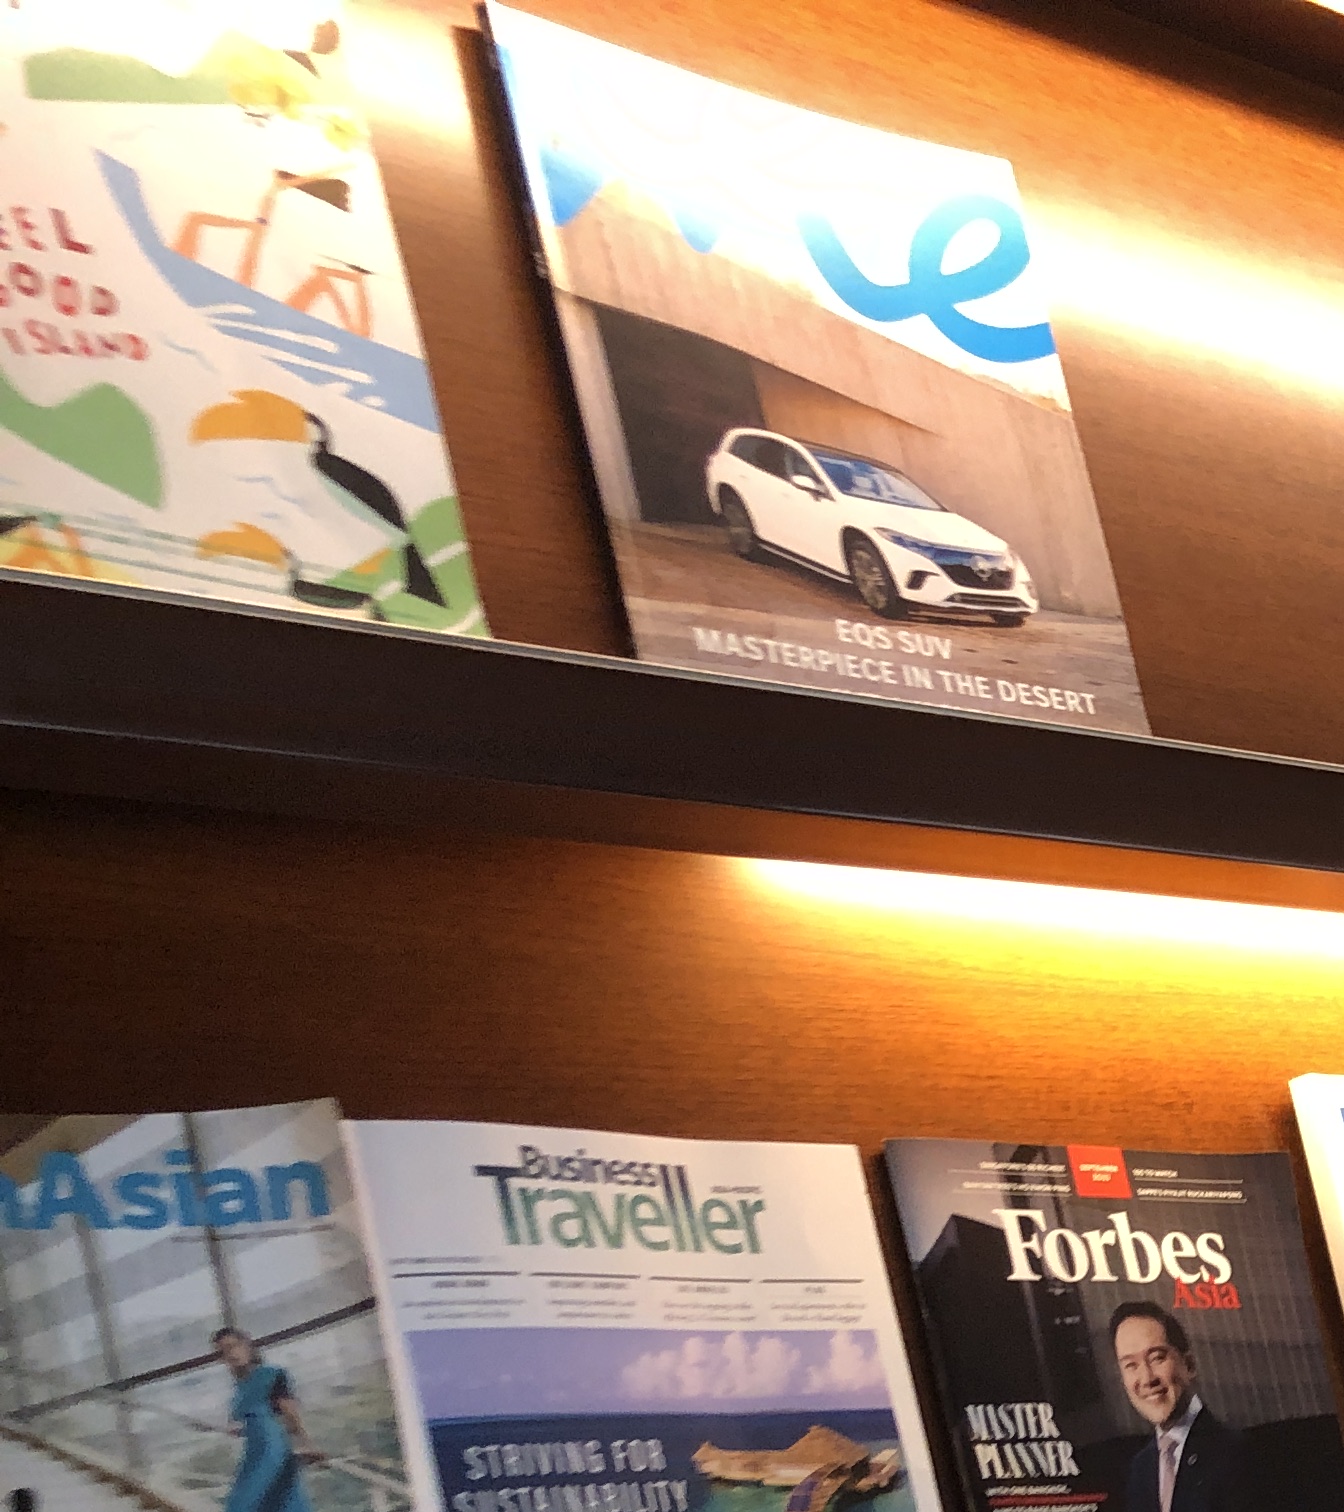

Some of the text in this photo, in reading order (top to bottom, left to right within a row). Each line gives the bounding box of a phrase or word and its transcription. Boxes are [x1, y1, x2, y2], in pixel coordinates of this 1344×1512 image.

[834, 618, 953, 660] EQS SUV
[692, 626, 1097, 716] MASTERPIECE IN THE DESERT
[518, 1143, 660, 1187] Business
[473, 1163, 765, 1255] Traveller
[991, 1207, 1233, 1285] Forbes
[1173, 1275, 1242, 1309] Asia
[964, 1402, 1061, 1441] MASTER
[463, 1438, 667, 1480] STRIVING FOR
[974, 1440, 1082, 1479] PLANNER
